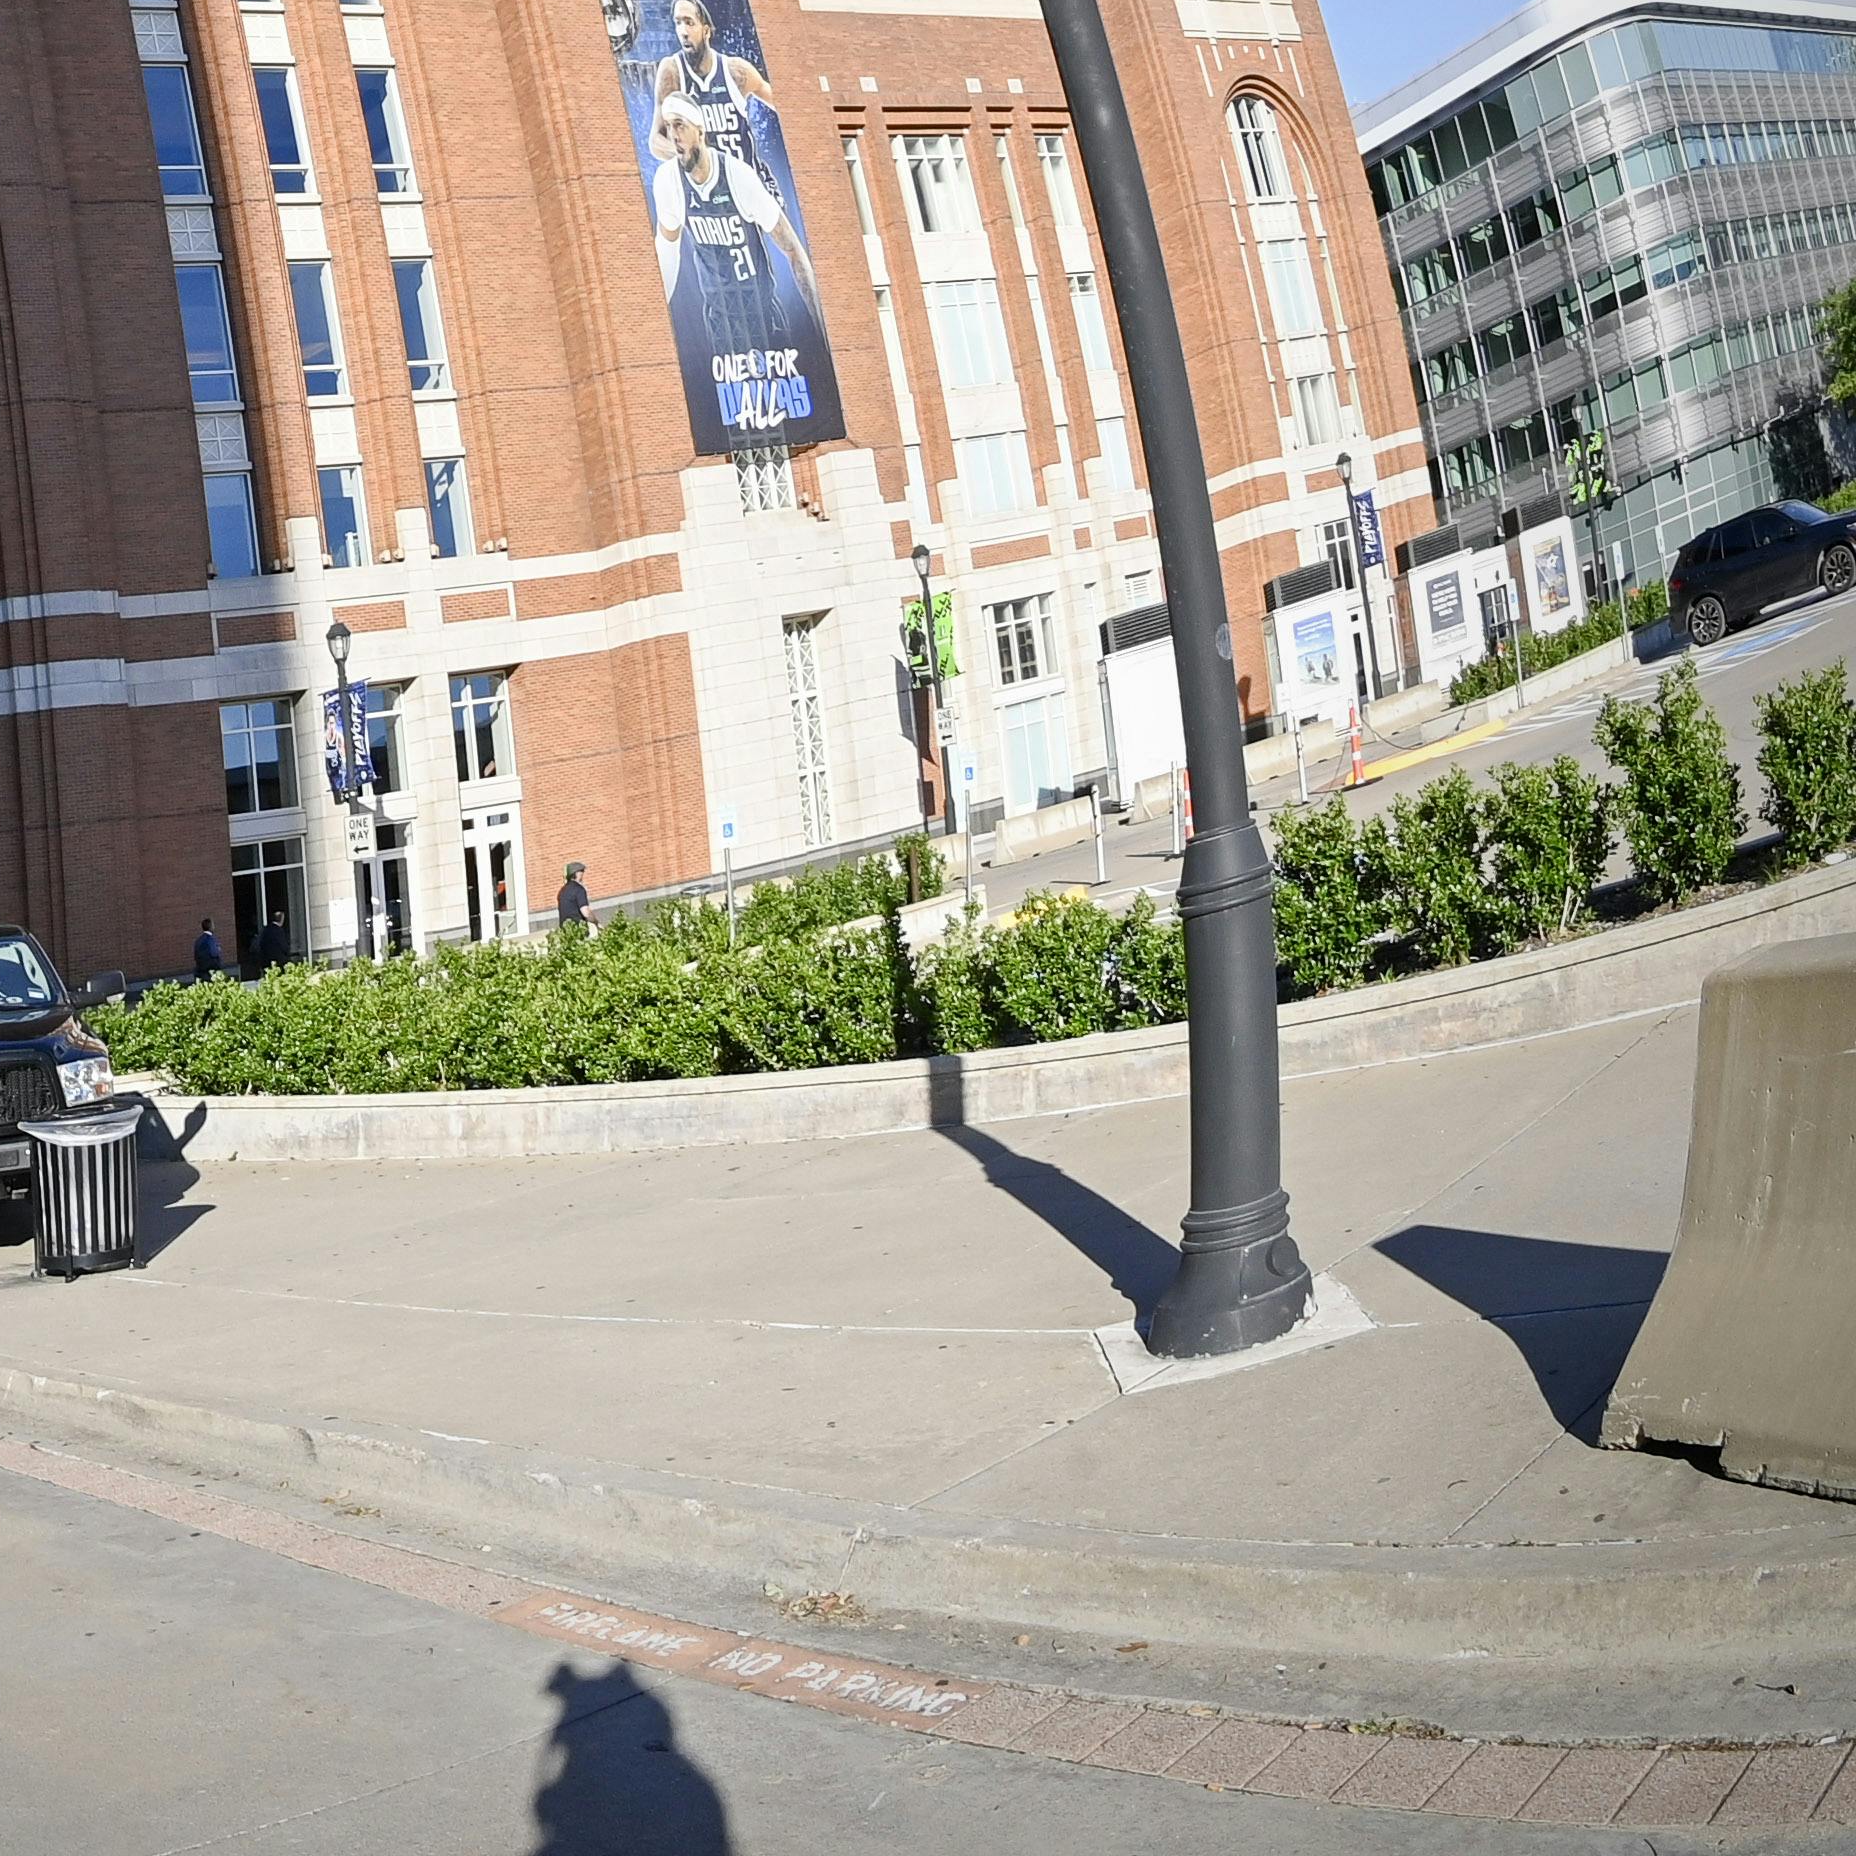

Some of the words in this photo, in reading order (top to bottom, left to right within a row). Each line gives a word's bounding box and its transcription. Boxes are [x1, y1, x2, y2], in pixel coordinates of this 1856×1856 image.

[688, 215, 746, 245] MAVS
[730, 245, 757, 281] 21
[712, 353, 750, 384] ONE
[765, 347, 801, 380] FOR
[735, 379, 787, 430] ALL
[1356, 500, 1378, 554] PLAYOFFS
[348, 692, 367, 765] PLAYOFFS
[349, 817, 368, 830] ONE
[349, 829, 370, 841] WAY
[706, 1646, 785, 1676] NO
[784, 1661, 970, 1717] PARKING
